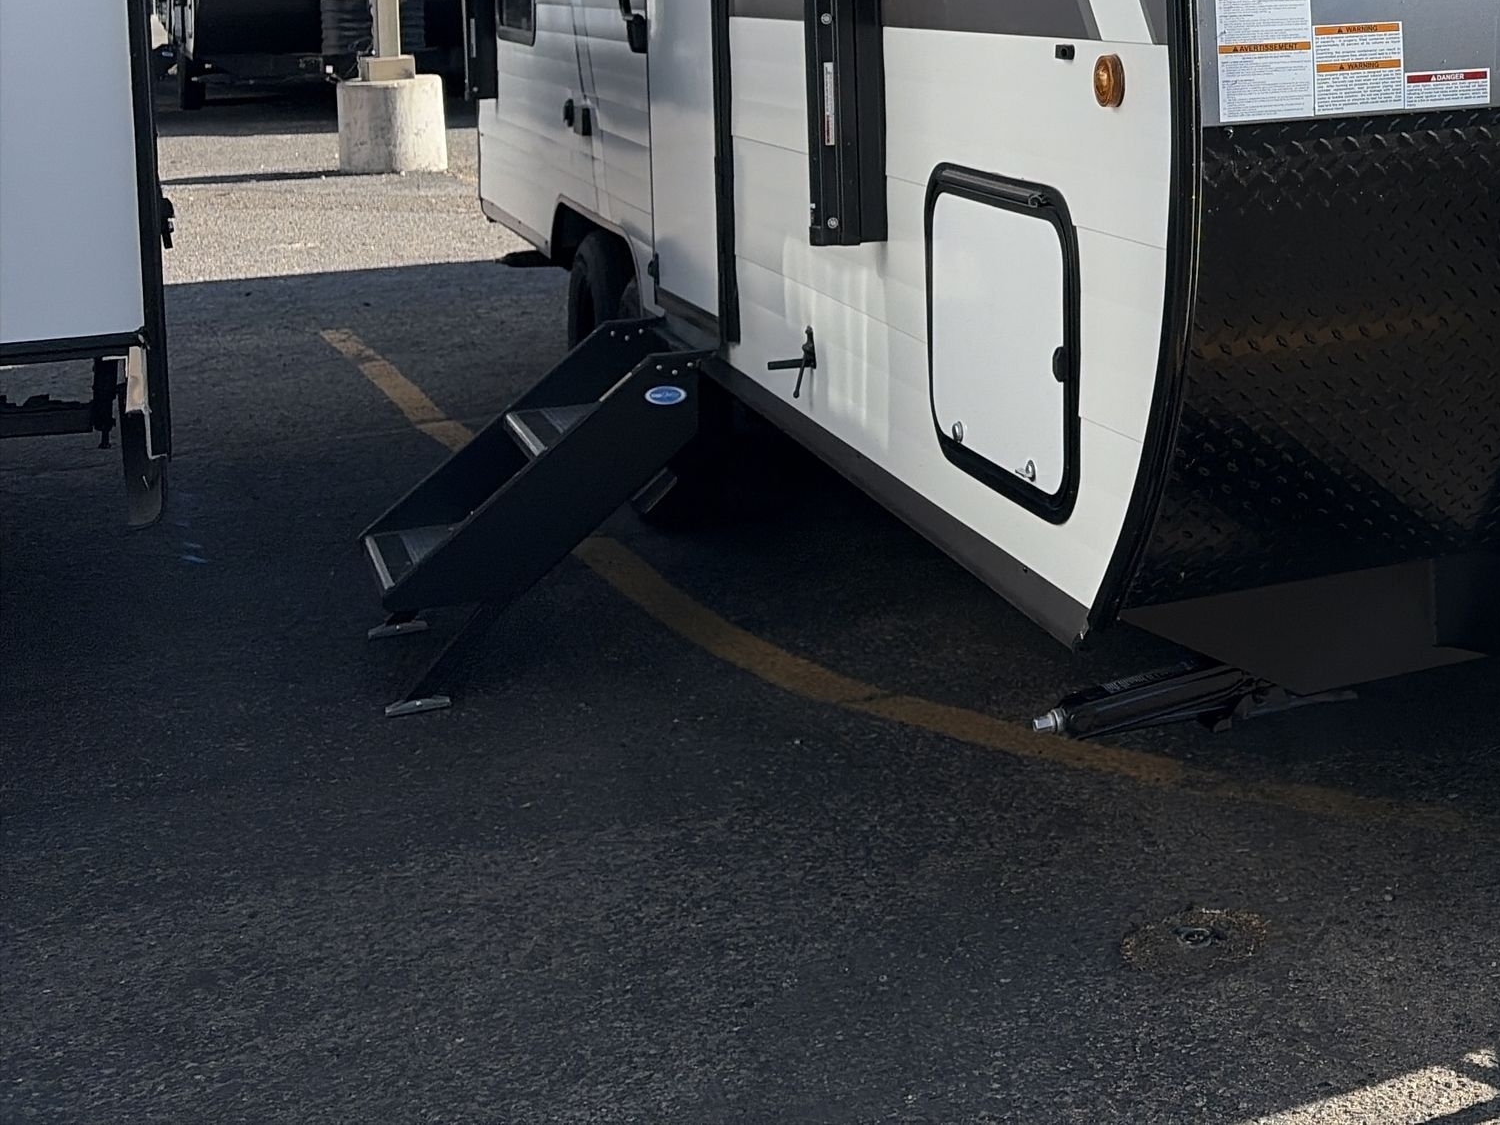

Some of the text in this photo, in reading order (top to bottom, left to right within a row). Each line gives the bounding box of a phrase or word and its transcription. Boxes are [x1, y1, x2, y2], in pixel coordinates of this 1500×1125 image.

[1345, 25, 1378, 33] WARNING
[1240, 43, 1298, 52] AVERTISSEMENT
[1347, 61, 1380, 70] WARNING
[1436, 73, 1465, 81] DANGER
